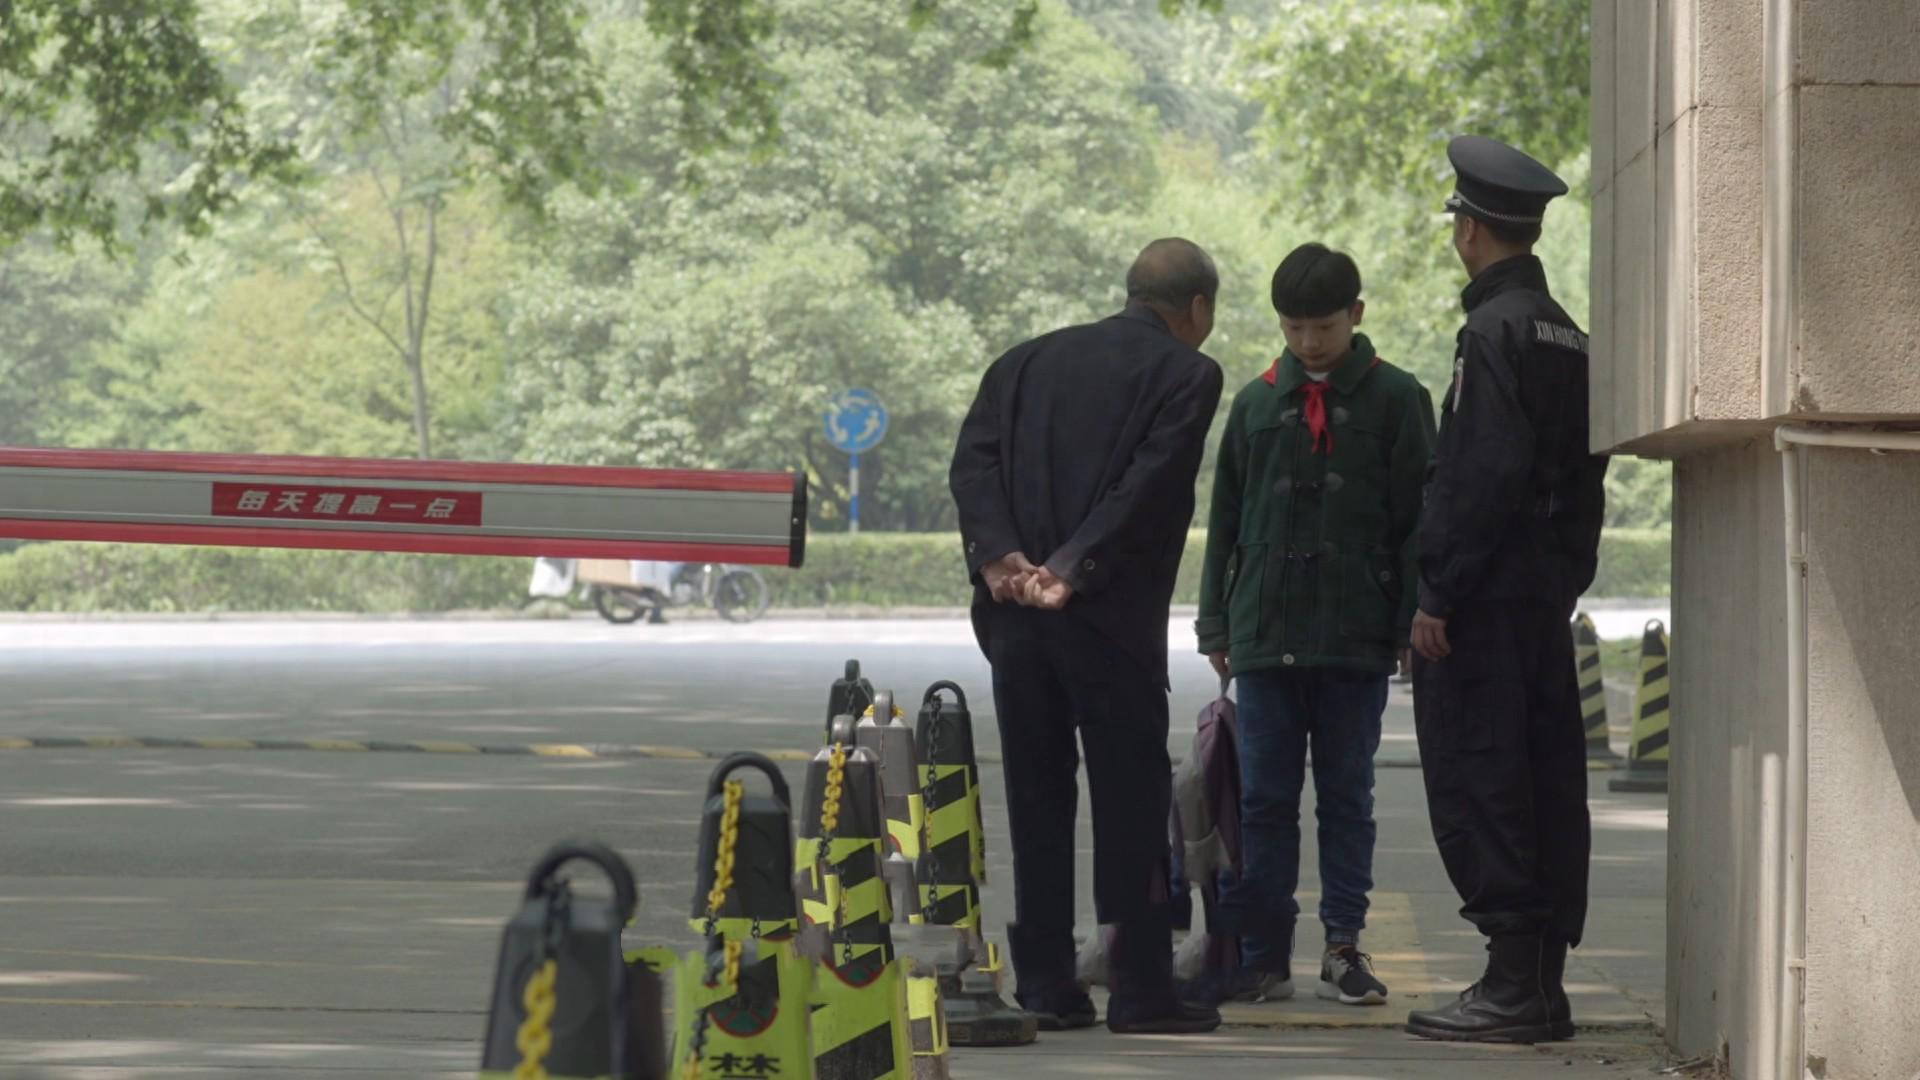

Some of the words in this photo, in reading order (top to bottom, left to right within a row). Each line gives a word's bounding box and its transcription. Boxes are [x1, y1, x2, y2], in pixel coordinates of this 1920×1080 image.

[236, 489, 458, 518] 每天提高一点
